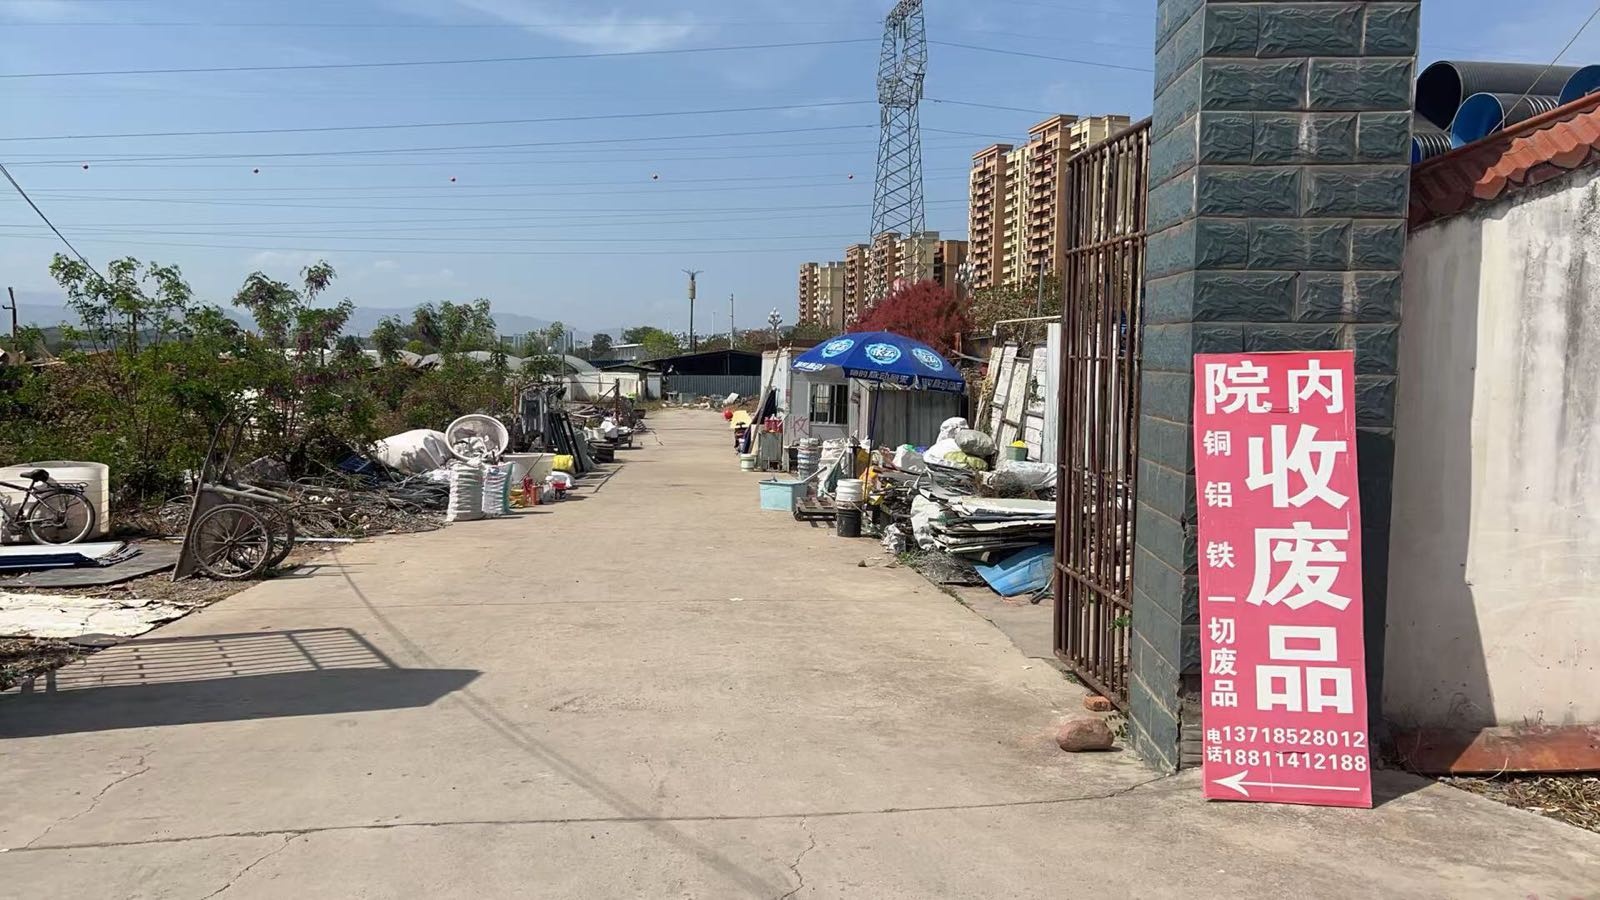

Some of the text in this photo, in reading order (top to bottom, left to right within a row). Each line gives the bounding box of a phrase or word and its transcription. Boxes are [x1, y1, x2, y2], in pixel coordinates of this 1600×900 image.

[1205, 360, 1344, 414] 院内
[1246, 424, 1354, 713] 收废品
[1206, 728, 1222, 763] 电话
[1222, 725, 1366, 748] 13718528012
[1223, 748, 1367, 772] 18811412188
